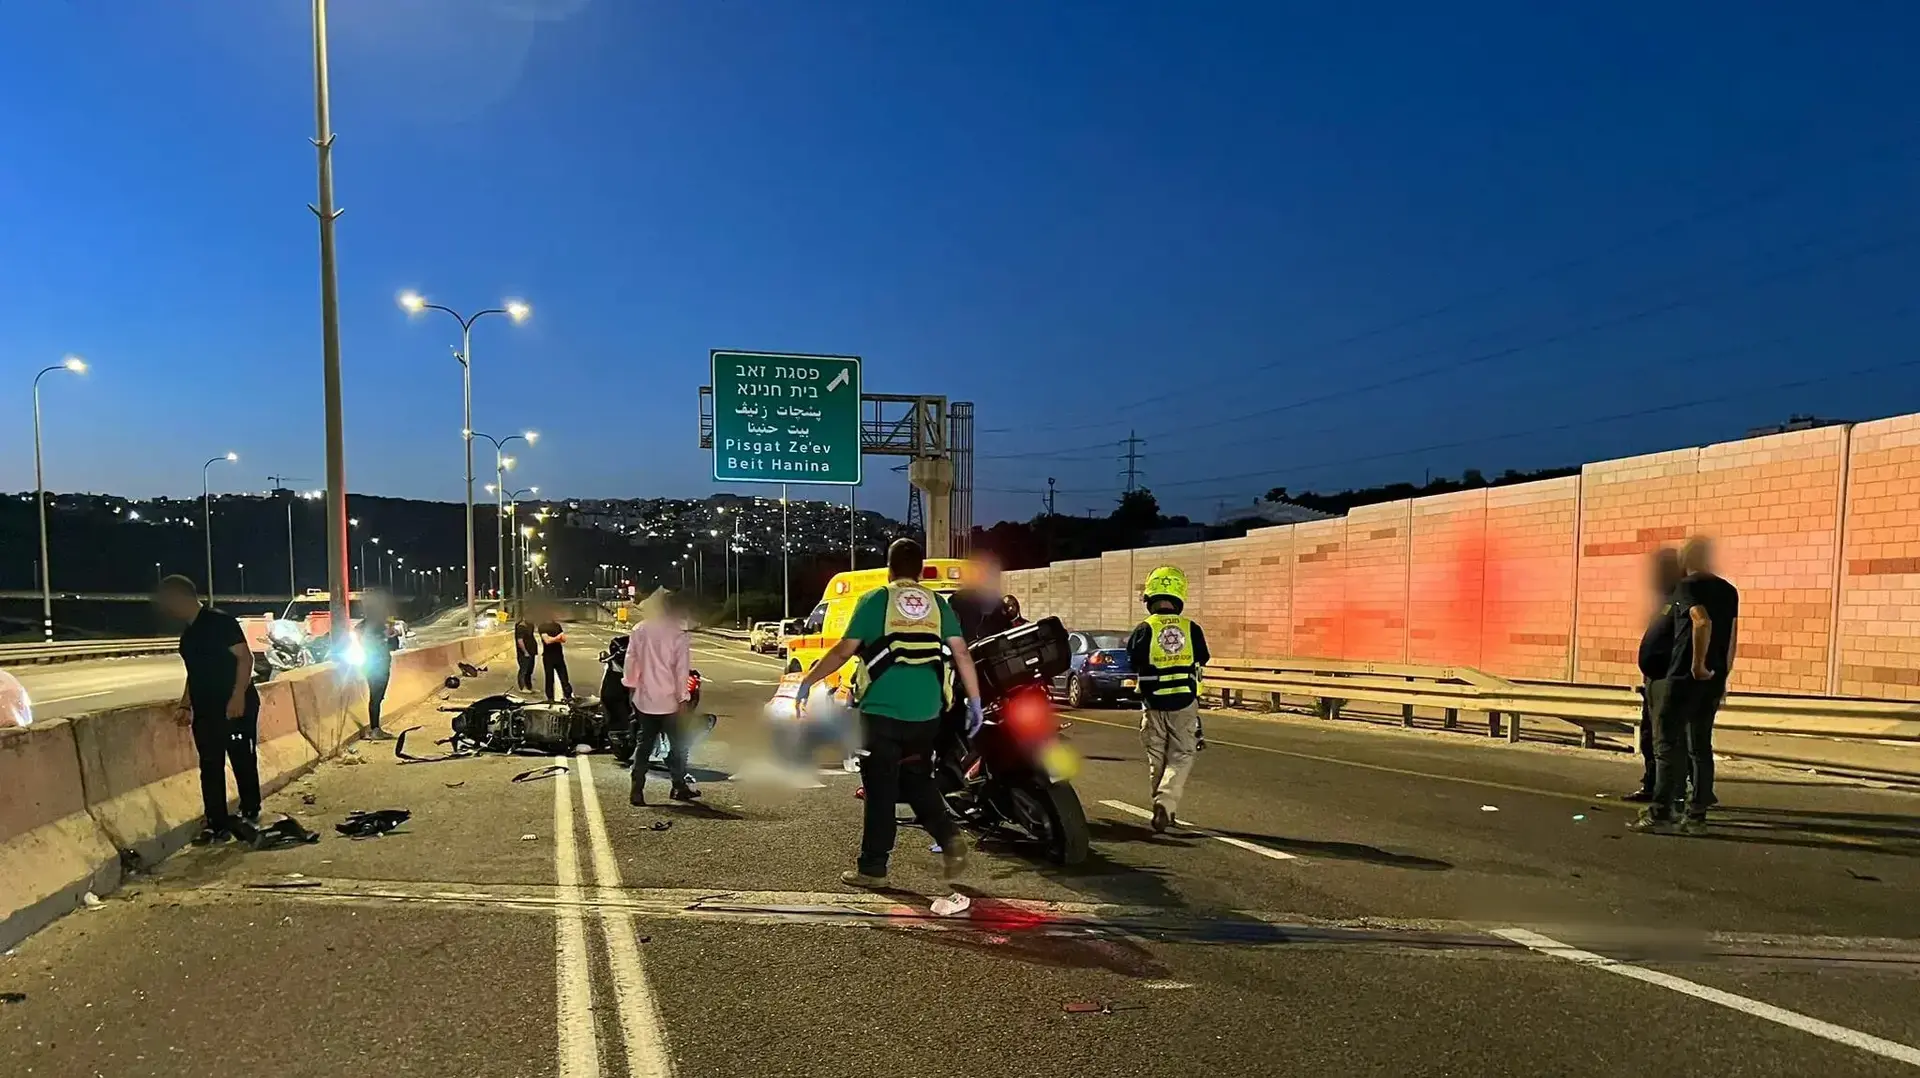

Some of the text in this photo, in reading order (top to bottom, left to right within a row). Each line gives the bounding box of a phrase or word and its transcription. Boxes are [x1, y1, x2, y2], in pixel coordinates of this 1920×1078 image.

[736, 364, 820, 380] פסגת זאב
[738, 383, 818, 398] בית חנינא
[747, 421, 810, 438] بيت حنينا
[726, 439, 831, 454] Pisgat Ze'ev
[728, 457, 830, 472] Beit Hanina
